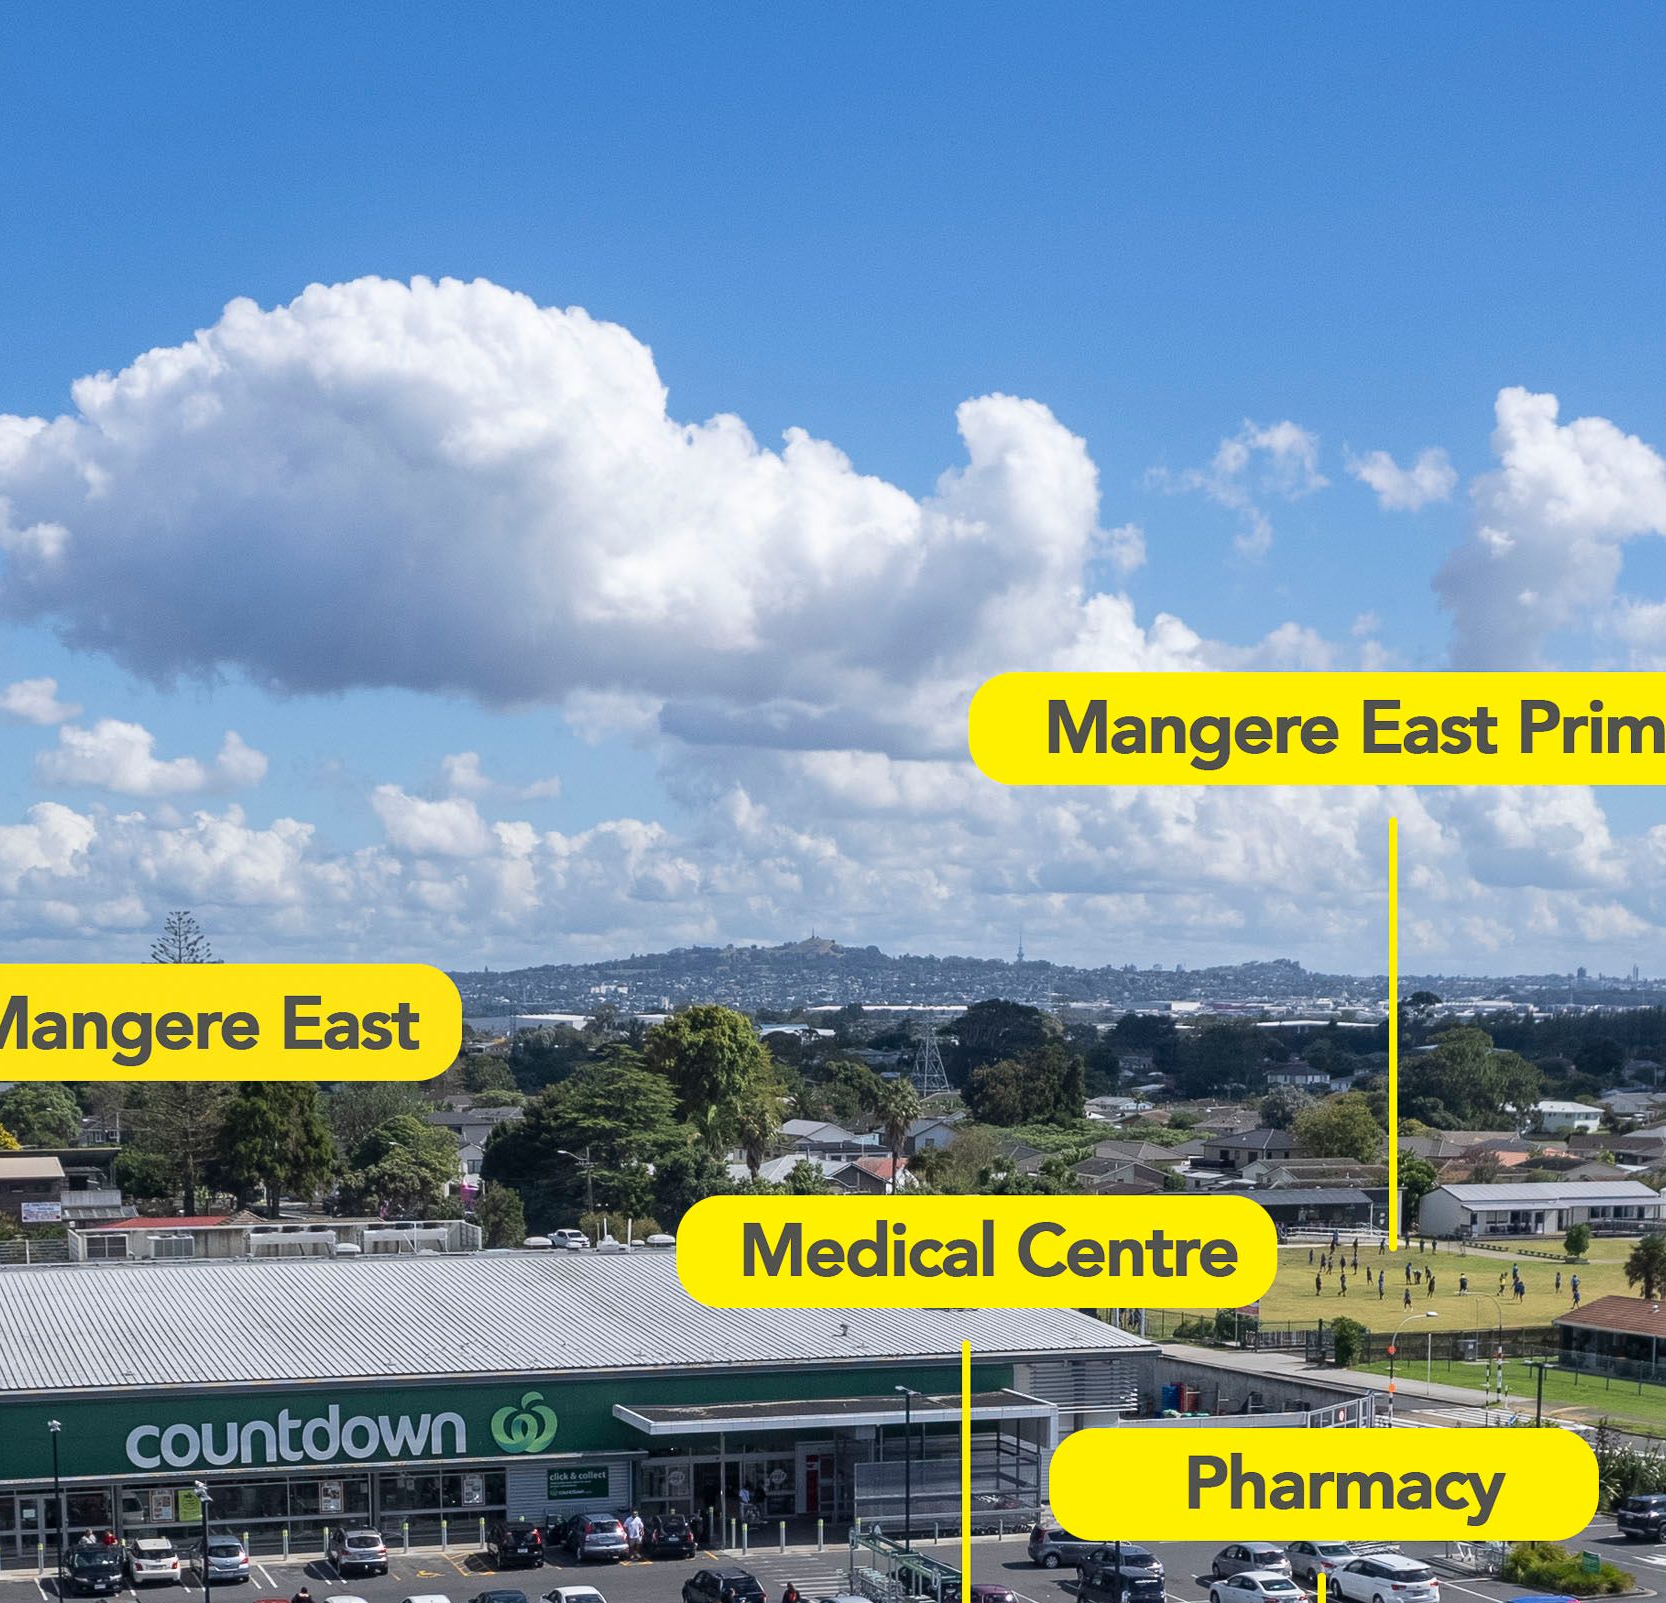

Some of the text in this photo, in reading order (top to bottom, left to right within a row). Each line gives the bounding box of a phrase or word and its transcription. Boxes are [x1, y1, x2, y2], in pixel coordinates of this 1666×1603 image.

[126, 1404, 467, 1471] countdown
[549, 1471, 606, 1480] click & collect
